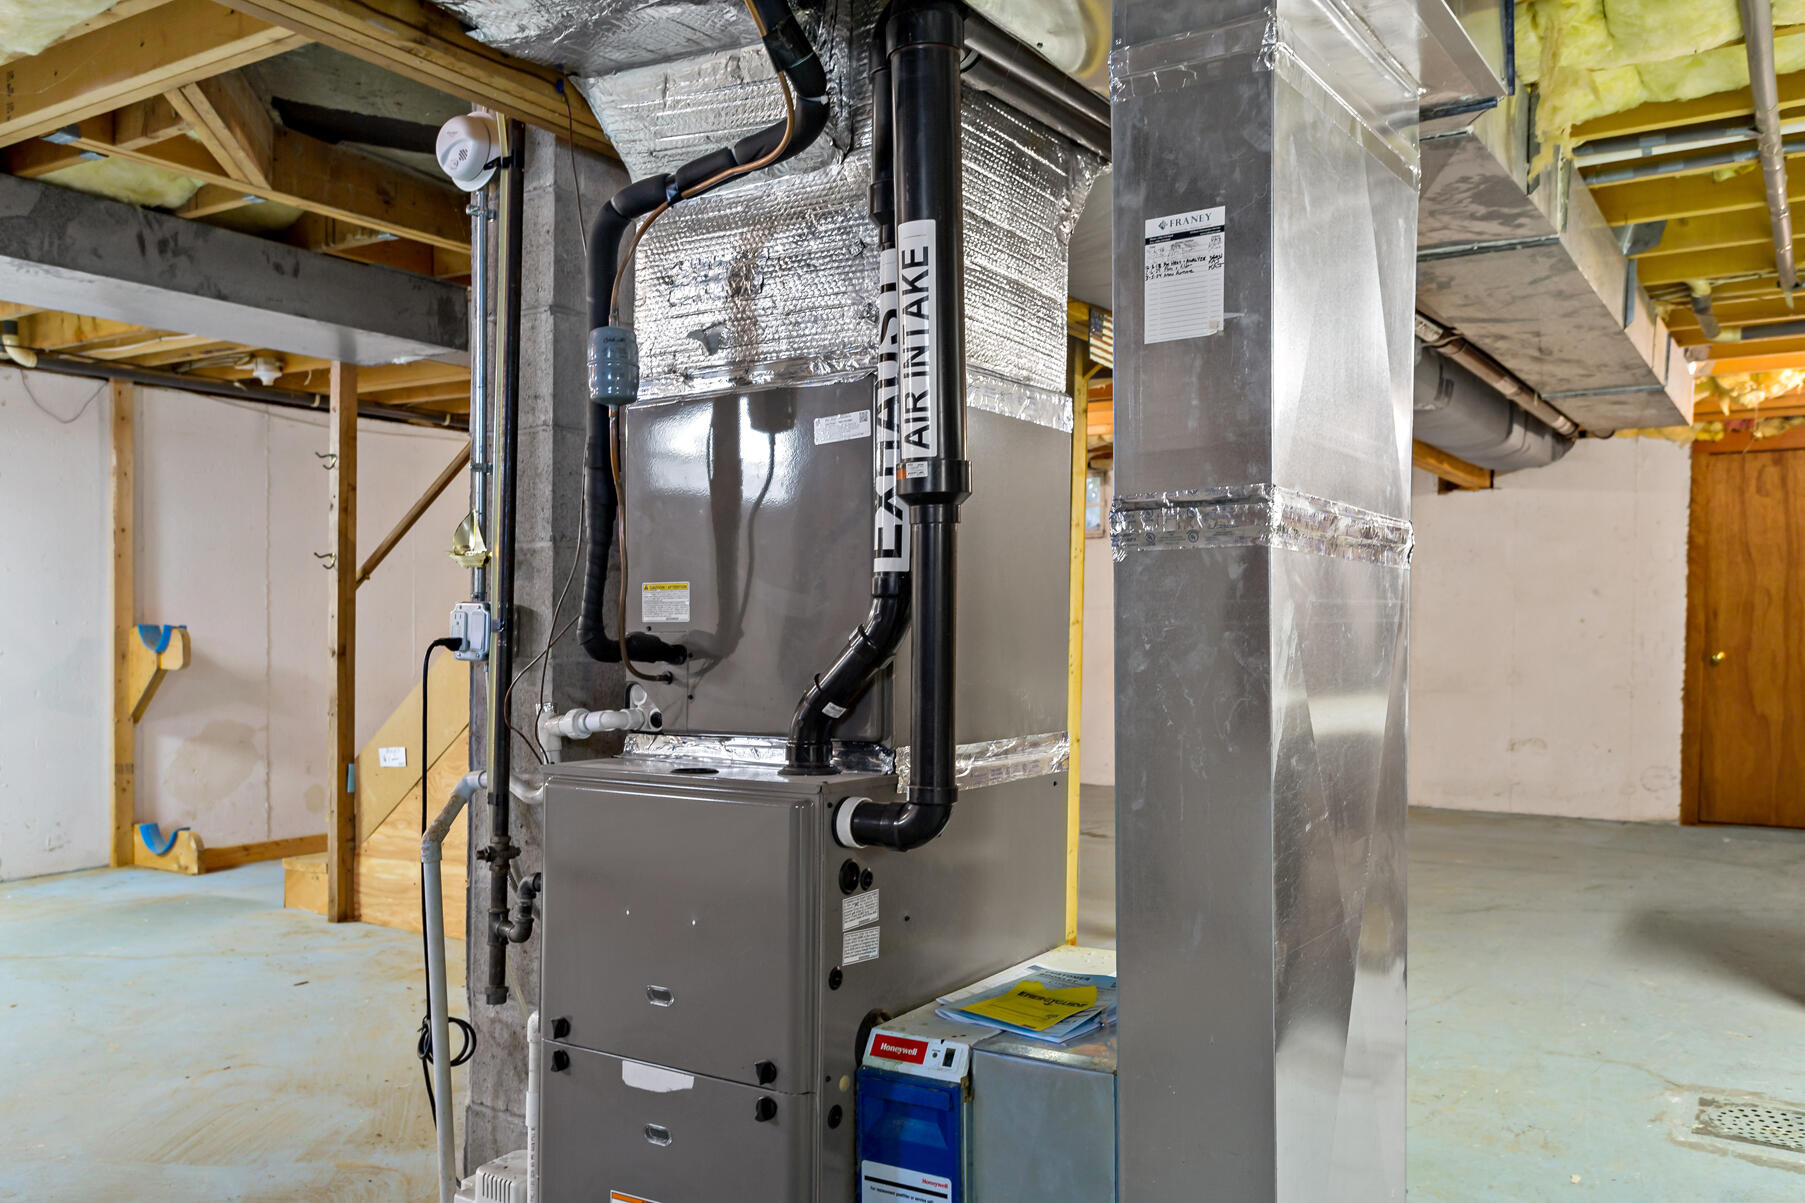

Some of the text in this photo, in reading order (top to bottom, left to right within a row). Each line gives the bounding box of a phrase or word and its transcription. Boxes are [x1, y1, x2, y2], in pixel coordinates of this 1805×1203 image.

[1169, 213, 1212, 227] FRANEY
[901, 246, 930, 379] INTAKE
[903, 390, 930, 450] AIR
[880, 1042, 918, 1056] Honeywell
[921, 1178, 949, 1189] Honeywell
